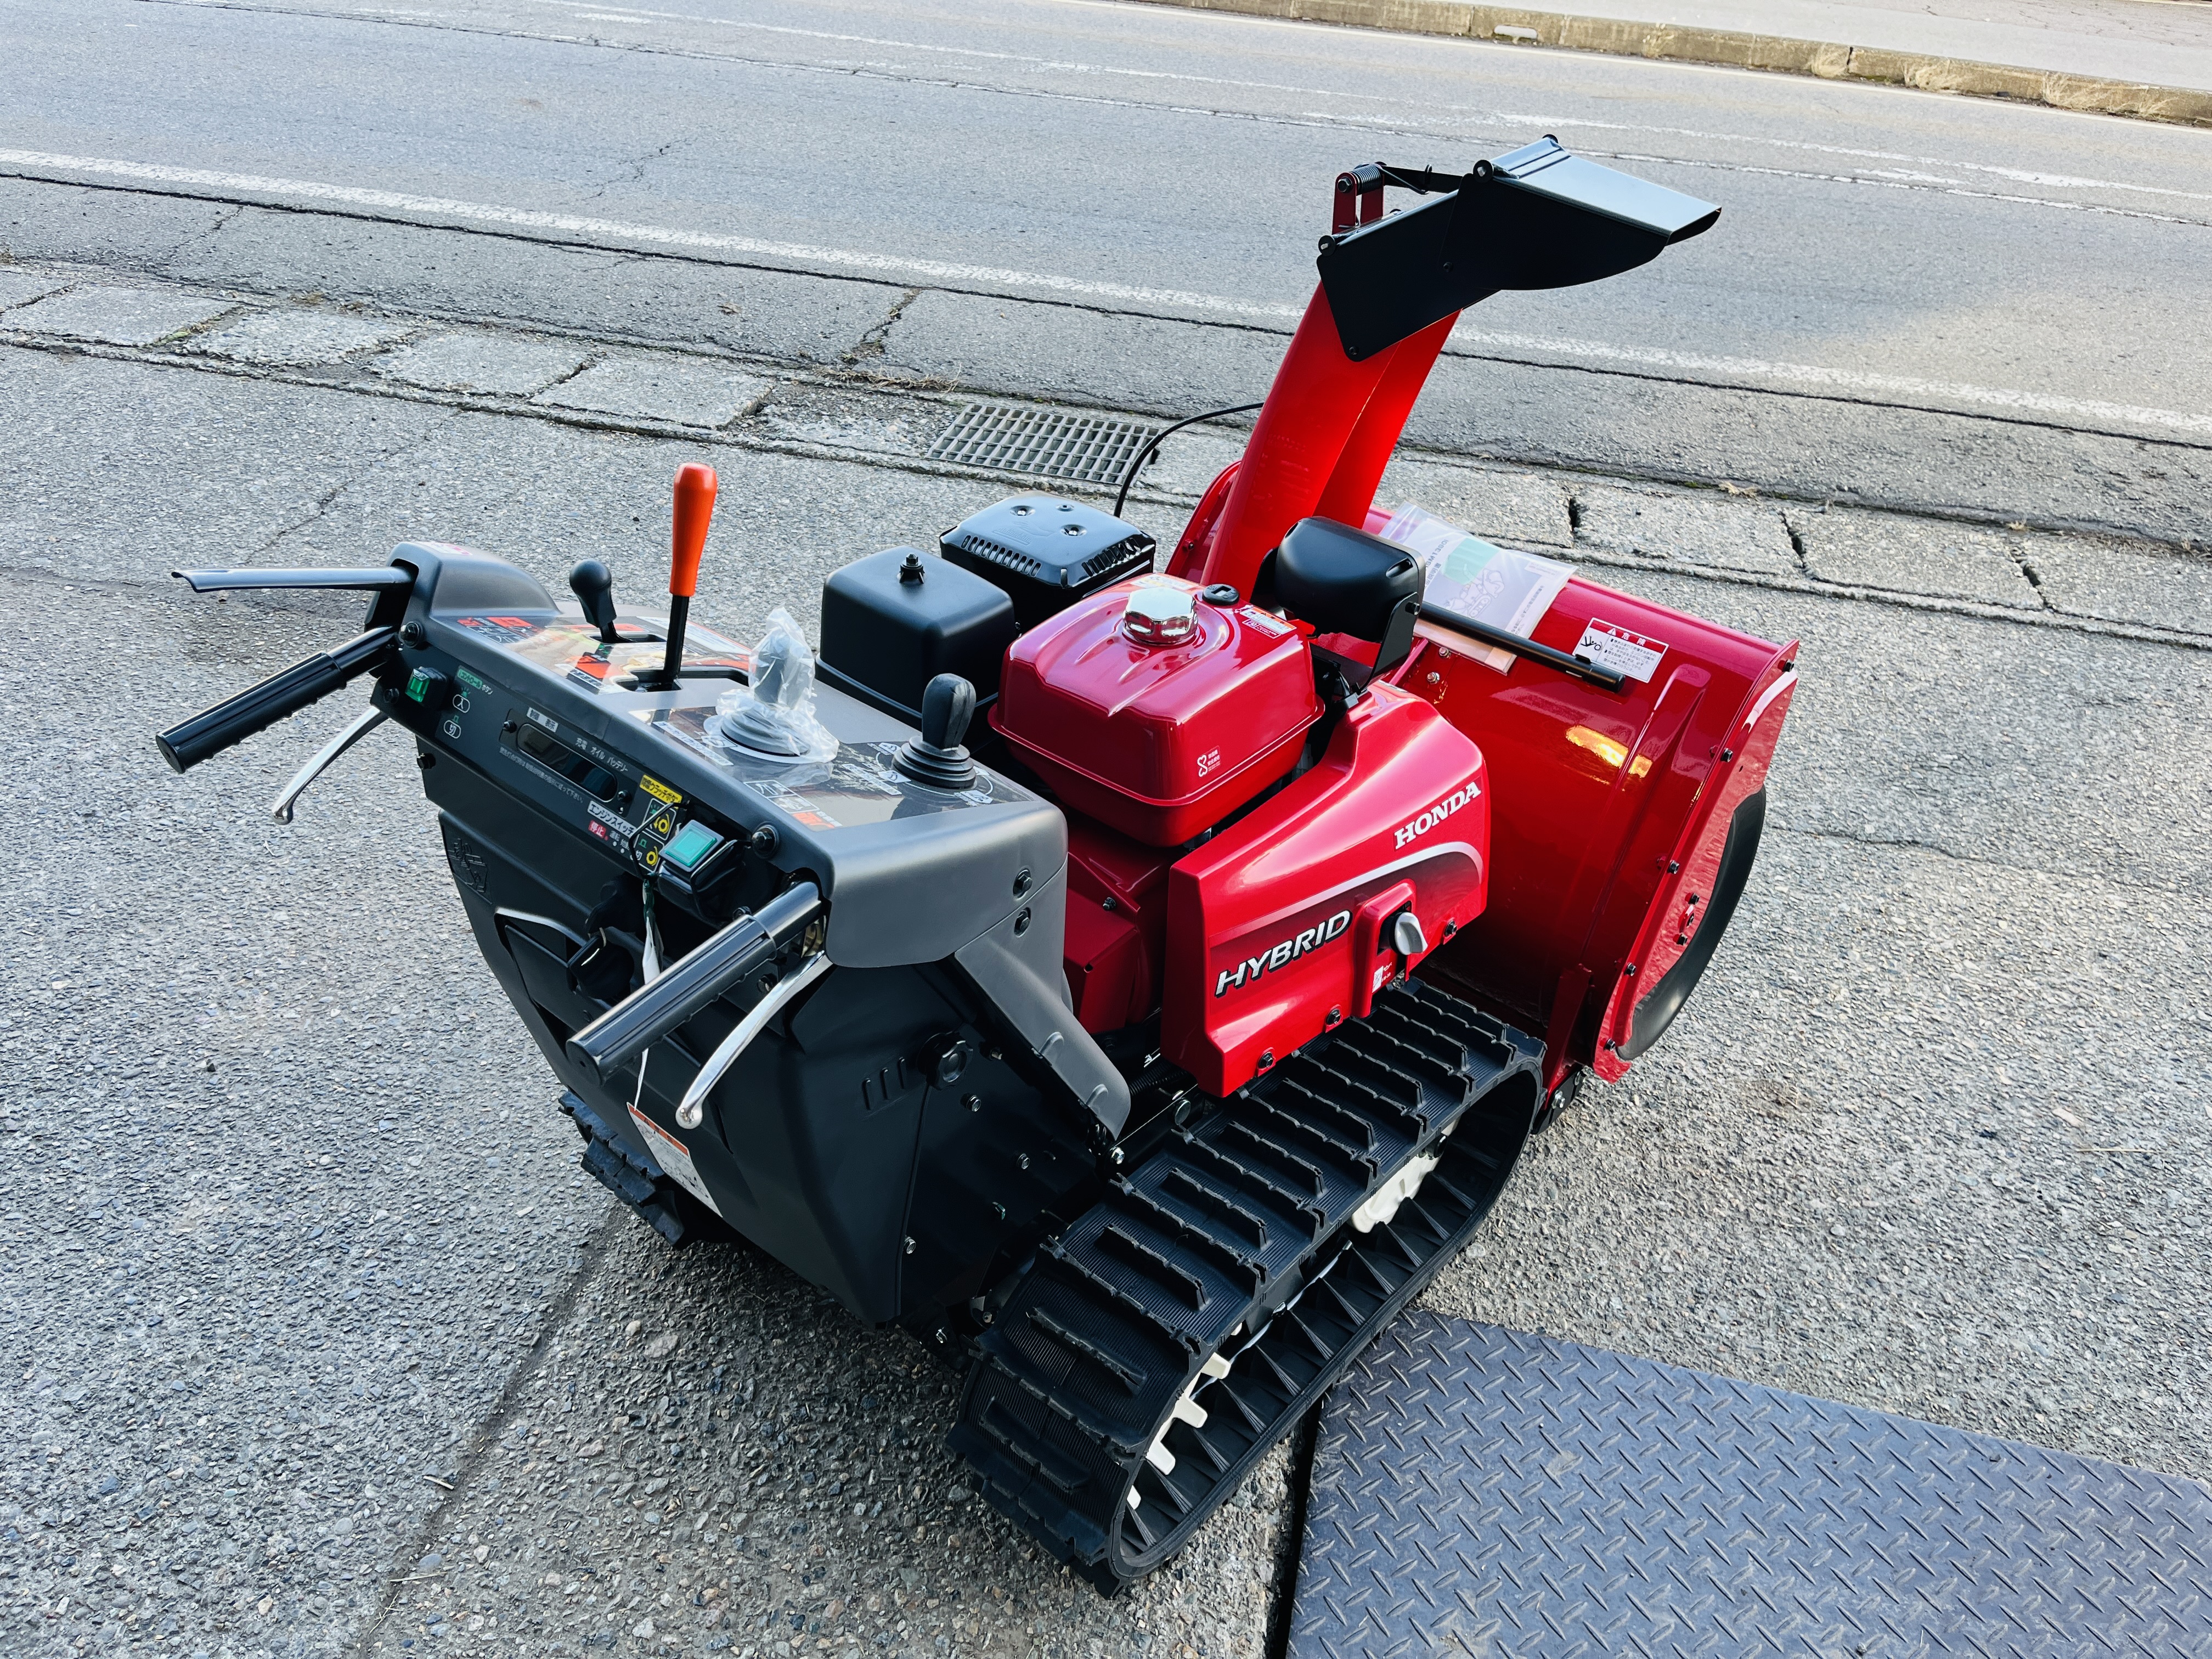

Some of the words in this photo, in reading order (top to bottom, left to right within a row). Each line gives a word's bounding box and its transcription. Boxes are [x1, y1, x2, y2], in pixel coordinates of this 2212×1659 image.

[589, 804, 635, 837] エンジンスイッチ
[1395, 781, 1481, 850] HONDA
[1214, 909, 1353, 999] HYBRID
